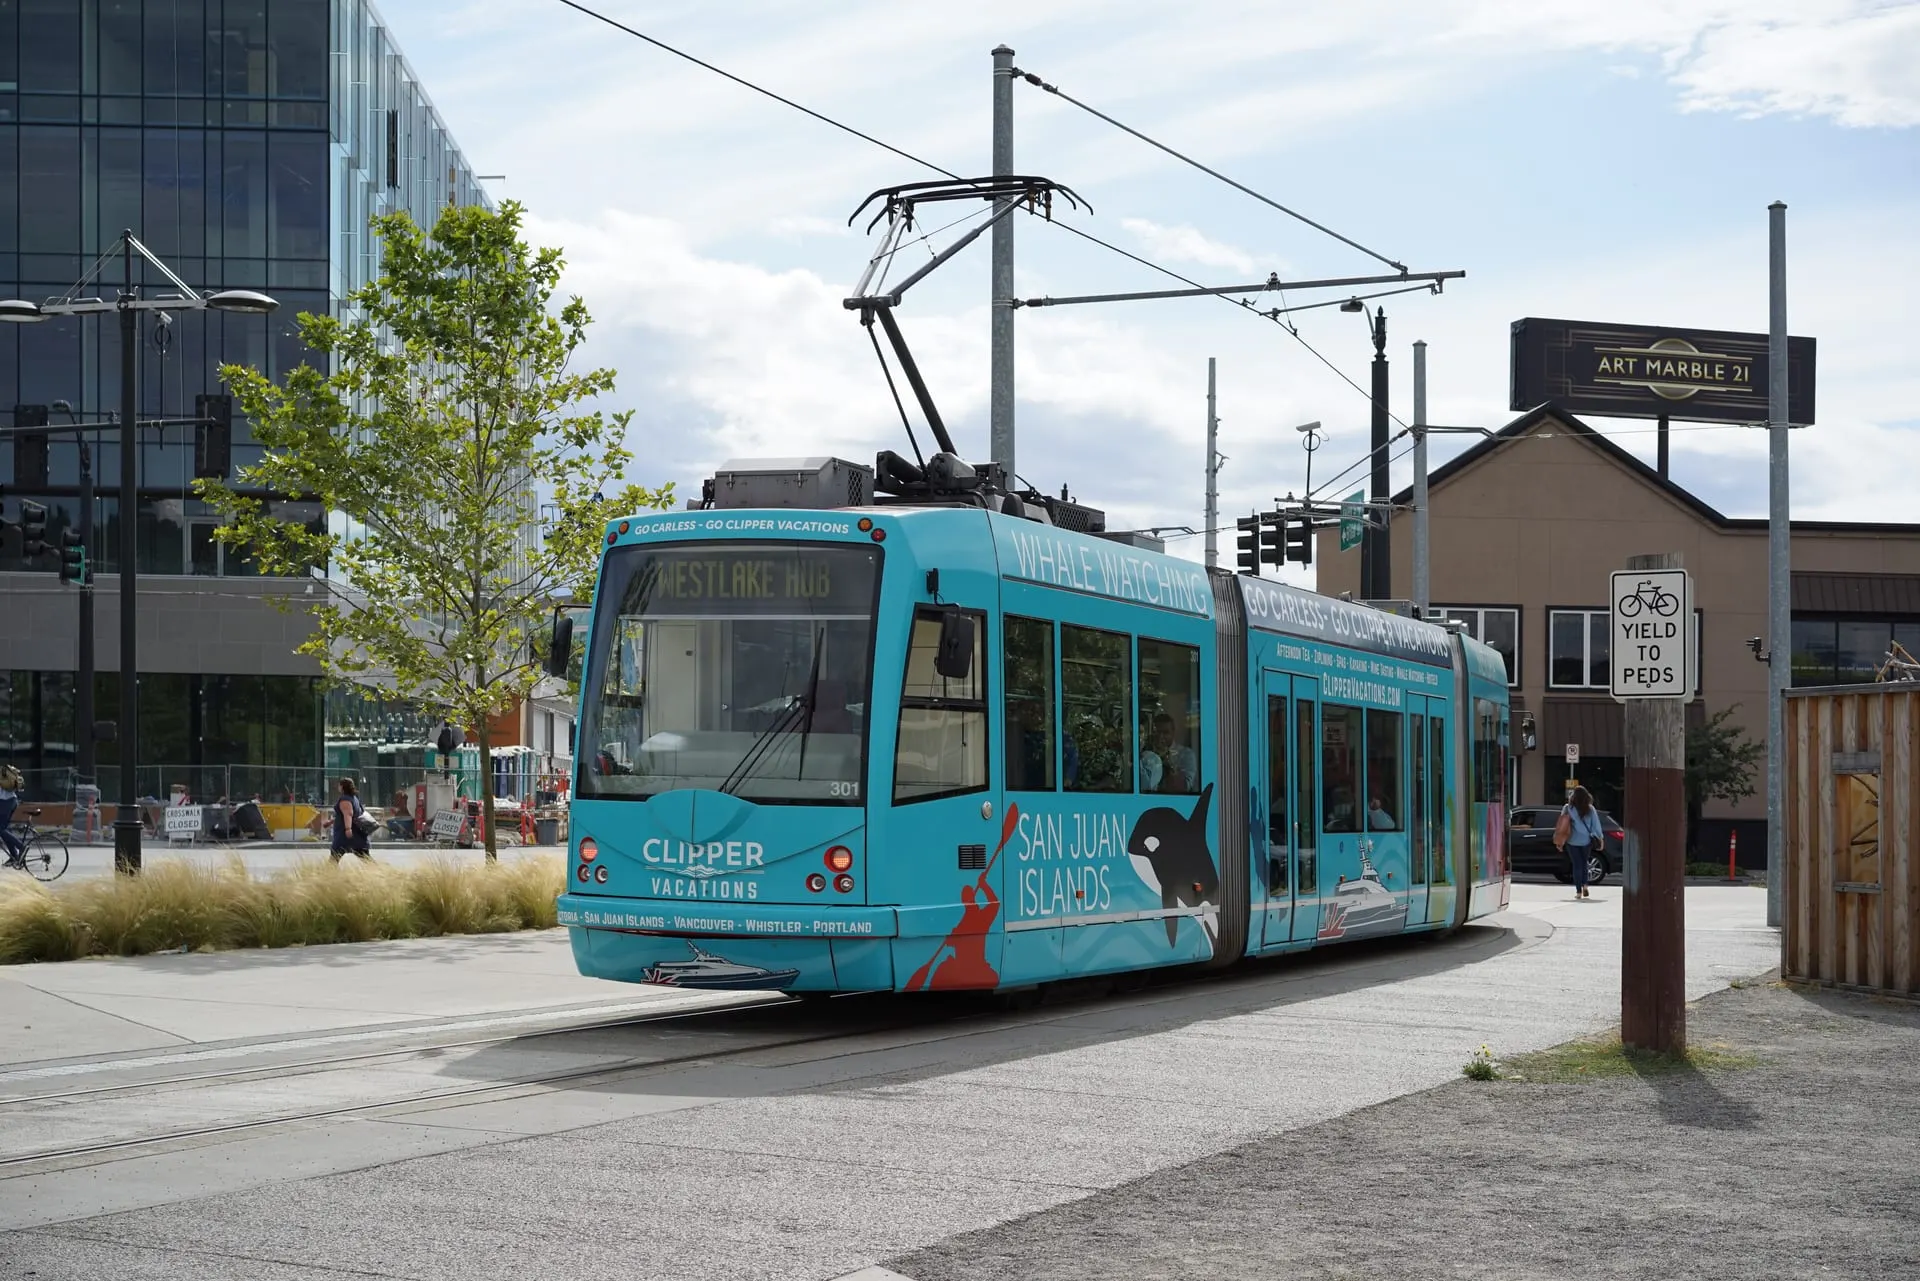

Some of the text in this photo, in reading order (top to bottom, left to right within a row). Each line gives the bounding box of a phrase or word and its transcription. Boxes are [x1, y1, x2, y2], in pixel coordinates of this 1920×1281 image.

[1598, 356, 1749, 383] ART MARBLE 21
[635, 519, 849, 535] GO CARLESS GO CLIPPER VACATIONS
[657, 560, 830, 598] WESTLAKE HUB
[1011, 530, 1207, 613] WHALE WATCHING
[1245, 583, 1268, 618] GO
[1331, 605, 1350, 636] GO
[1351, 611, 1395, 647] CLIPPER
[1393, 622, 1449, 658] VACATIONS
[1621, 622, 1676, 639] YIELD
[1637, 645, 1660, 661] TO
[1624, 667, 1673, 684] PEDS
[830, 781, 859, 797] 301
[167, 808, 200, 818] CROSSWALK
[168, 820, 199, 829] CLOSED
[433, 823, 459, 833] CLOSED
[1019, 813, 1126, 861] SAN JUAN
[643, 838, 764, 866] CLIPPER
[651, 876, 758, 900] VACATIONS
[1020, 865, 1110, 917] ISLANDS
[584, 911, 600, 924] SAN
[602, 911, 624, 926] JUAN
[625, 913, 664, 928] ISLANDS
[674, 916, 734, 931] VANCOUVER
[746, 919, 801, 933] WHISTLER
[813, 920, 872, 933] PORTLAND
